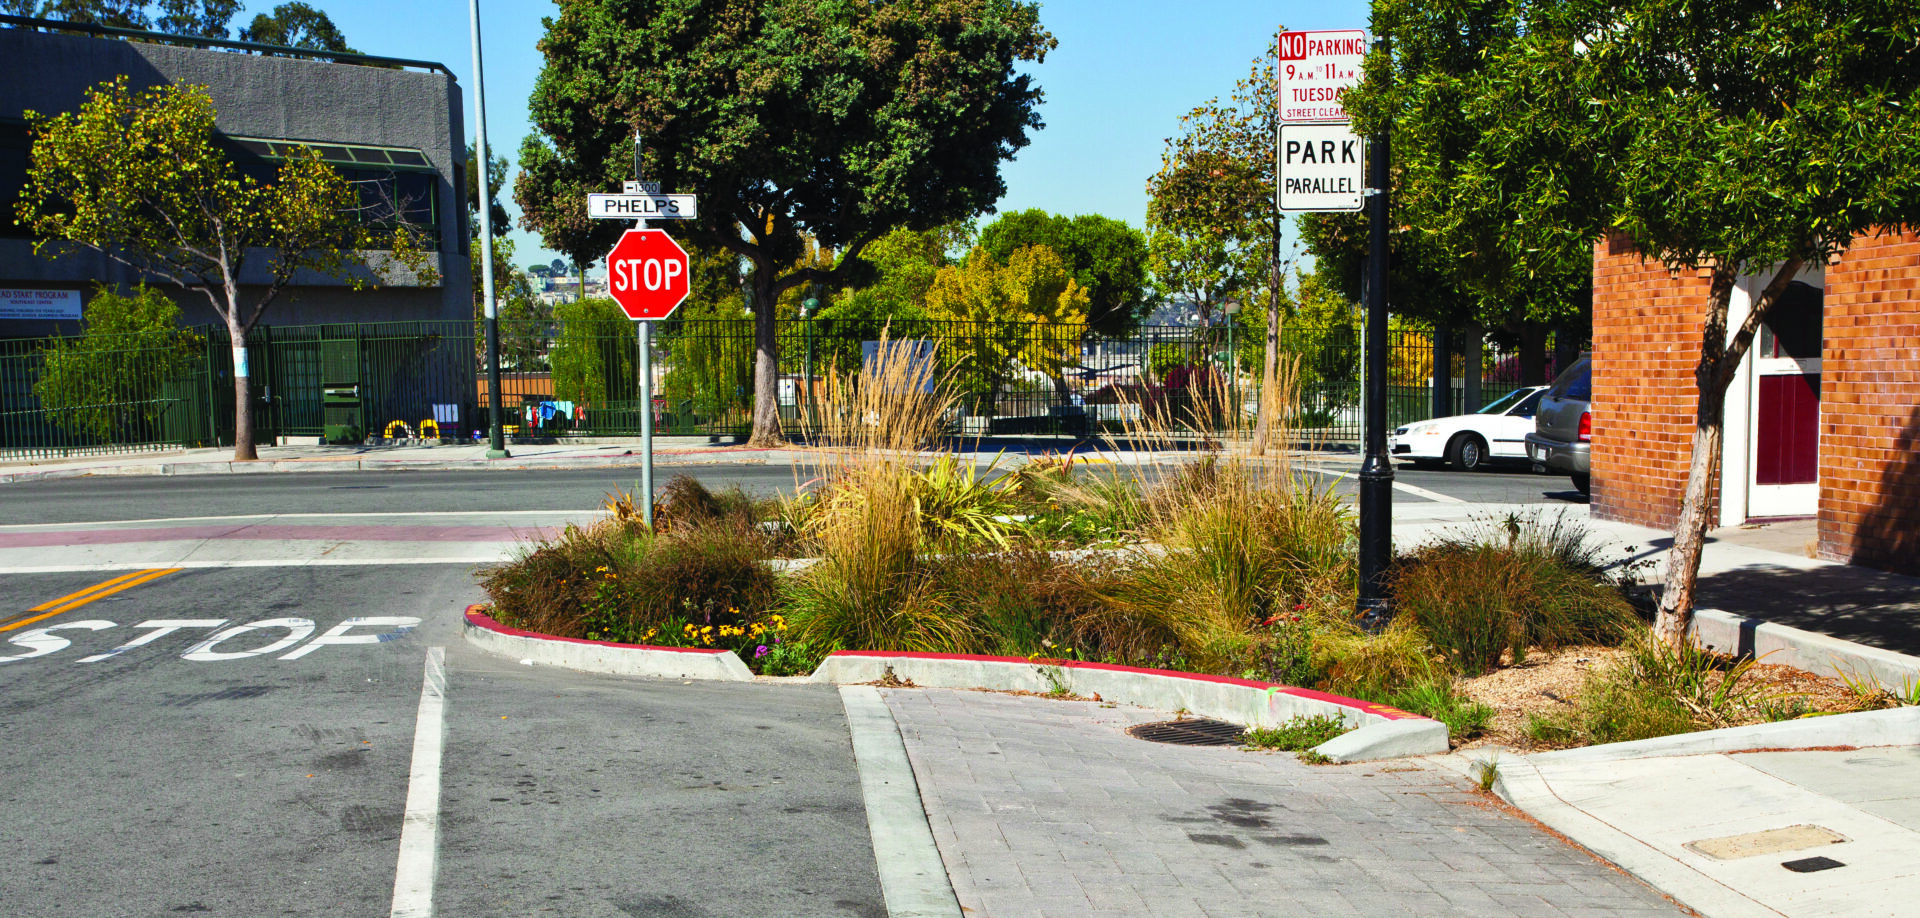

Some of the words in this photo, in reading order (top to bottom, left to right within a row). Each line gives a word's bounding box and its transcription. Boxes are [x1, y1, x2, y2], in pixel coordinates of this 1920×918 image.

[1281, 35, 1304, 58] NO
[1309, 38, 1362, 56] PARKING
[1286, 64, 1296, 80] 9
[1325, 63, 1336, 80] 11
[1286, 108, 1316, 118] STREET
[1286, 140, 1356, 164] PARK
[1285, 177, 1356, 194] PARALLEL
[604, 199, 680, 213] PHELPS
[614, 258, 682, 292] STOP
[0, 291, 12, 299] AD
[13, 291, 33, 299] START
[35, 291, 69, 300] PROGRAM
[0, 616, 423, 664] STOP
